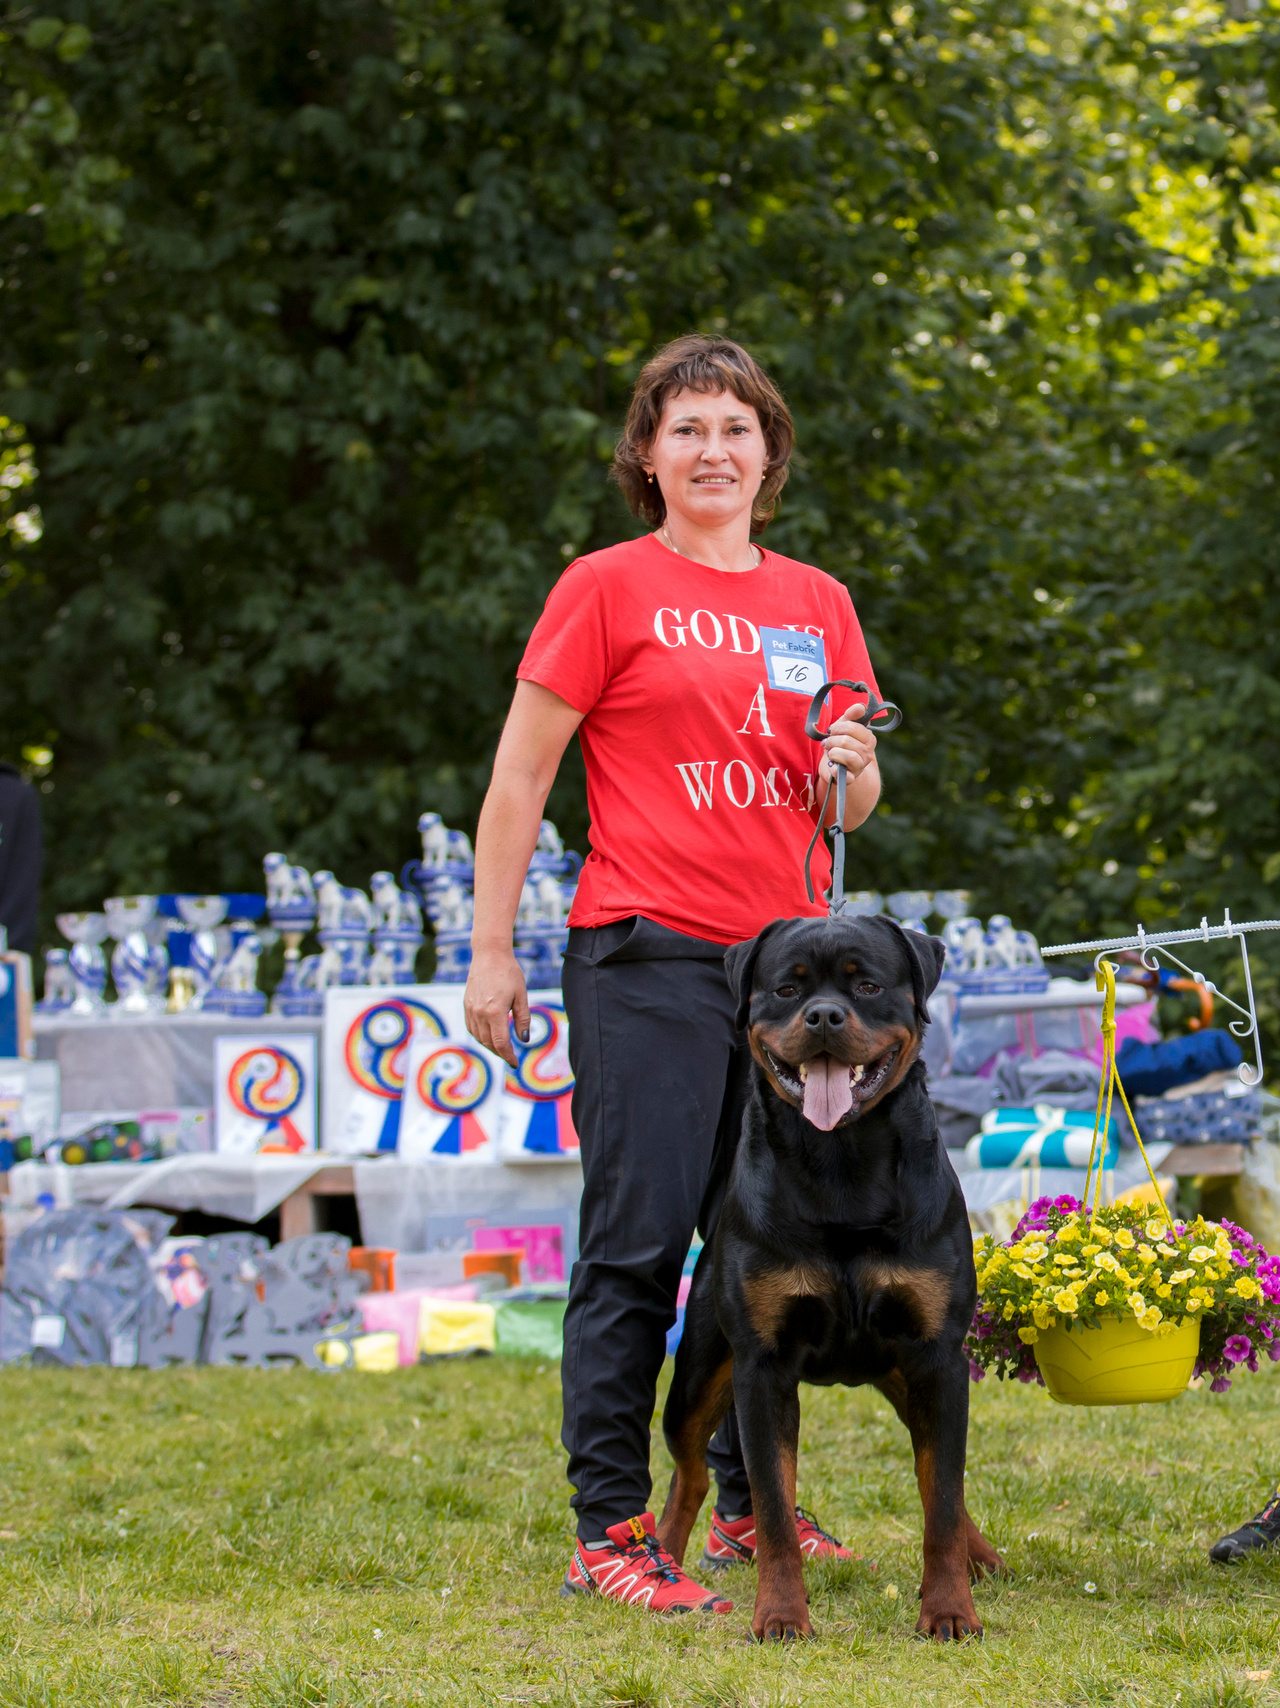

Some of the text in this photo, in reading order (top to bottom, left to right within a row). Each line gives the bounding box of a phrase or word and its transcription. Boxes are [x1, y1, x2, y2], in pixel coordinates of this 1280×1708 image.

[653, 607, 761, 655] GOD
[772, 640, 788, 650] Pet
[788, 642, 815, 655] Fabric
[785, 664, 809, 682] 16
[737, 683, 775, 737] A
[574, 1547, 592, 1582] LOMON
